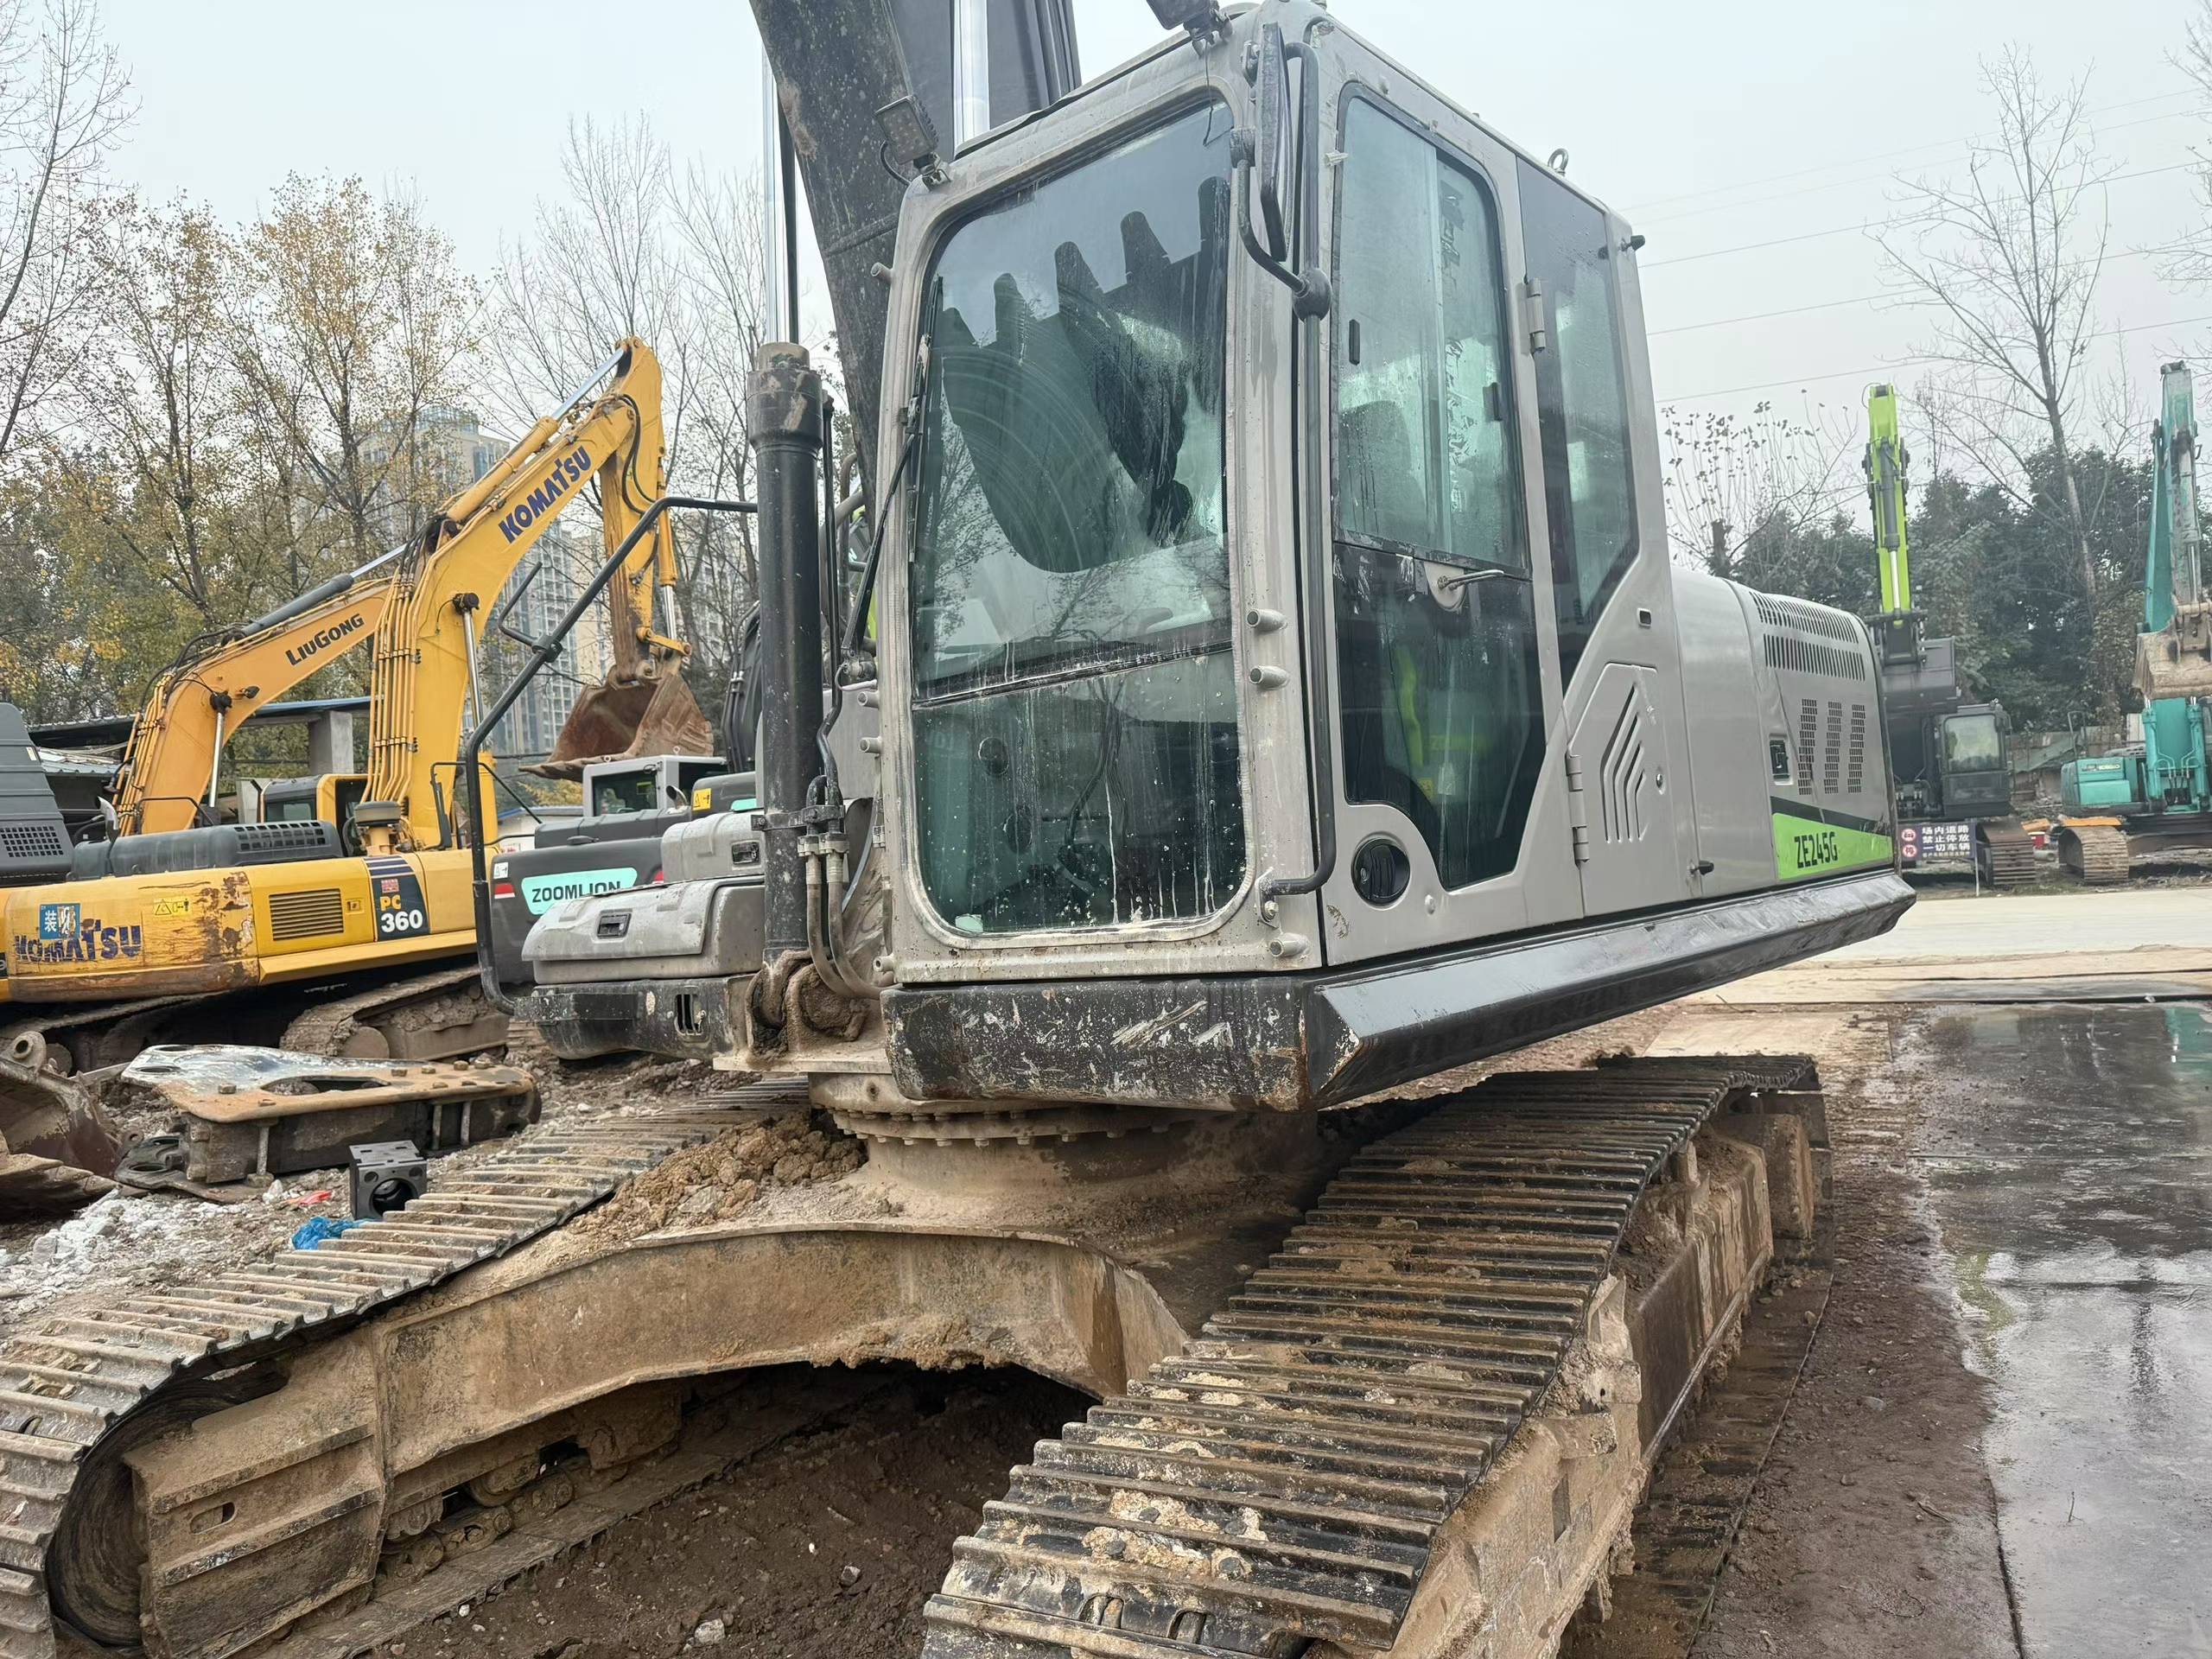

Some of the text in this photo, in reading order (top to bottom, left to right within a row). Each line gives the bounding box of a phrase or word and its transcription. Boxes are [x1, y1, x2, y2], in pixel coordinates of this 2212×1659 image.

[498, 445, 591, 543] KOMATSU
[1794, 831, 1838, 868] ZE245G
[380, 895, 401, 911] PC
[531, 881, 621, 904] ZOOMLION
[381, 910, 423, 932] 360
